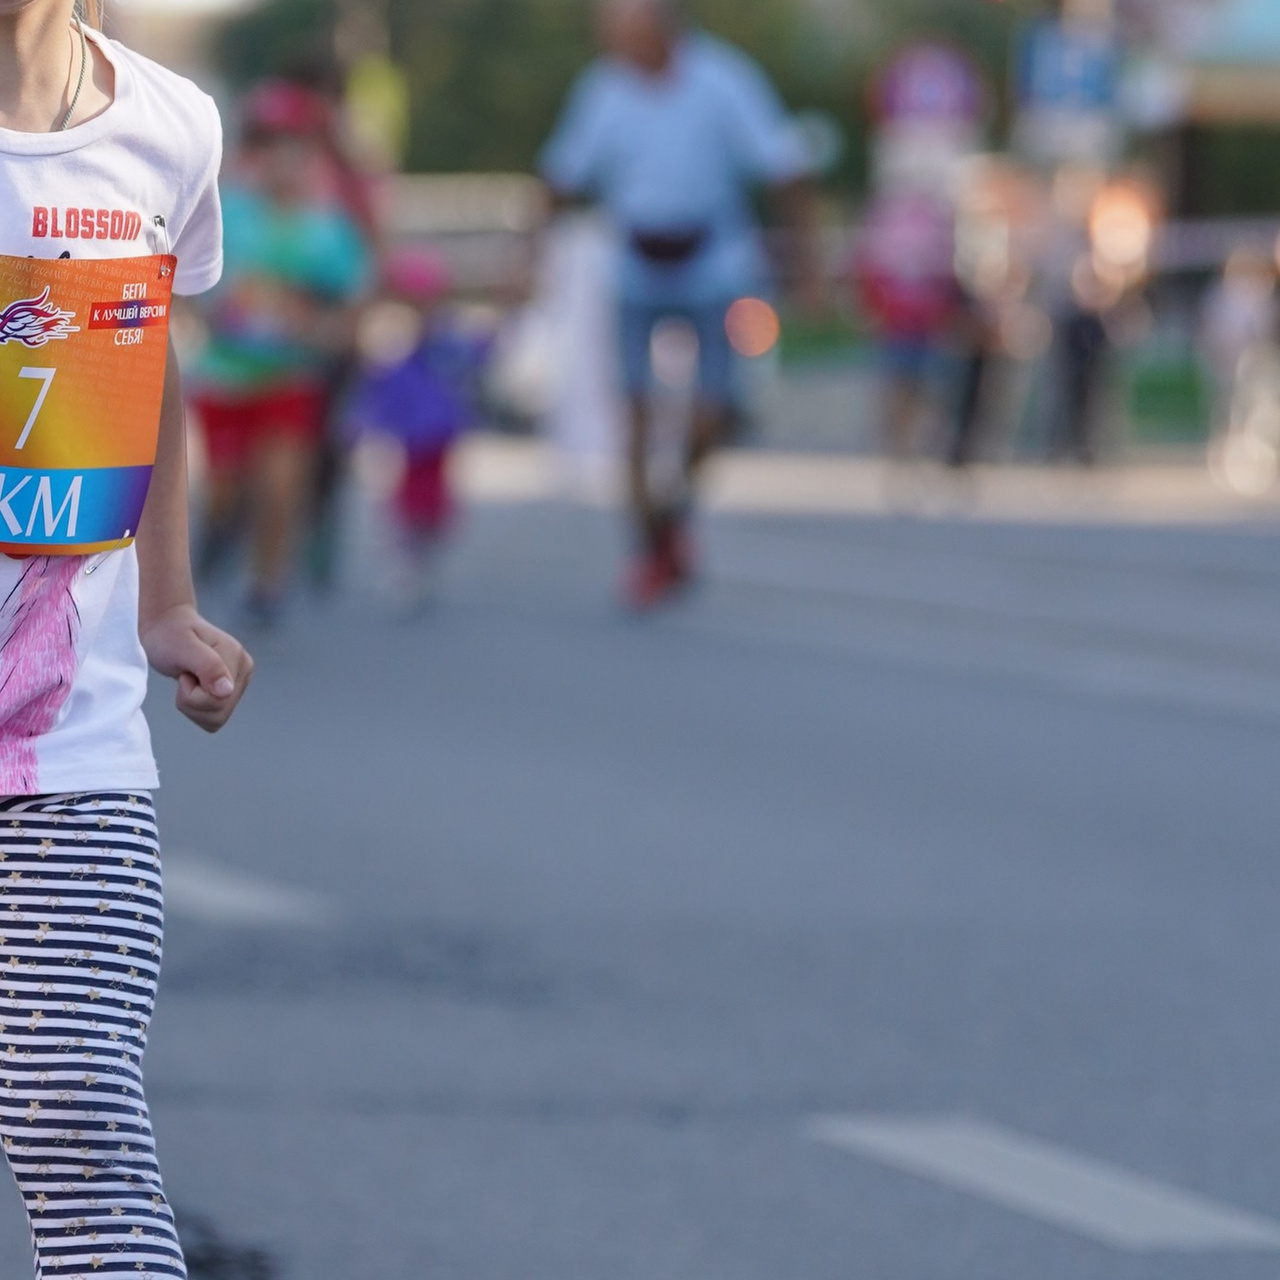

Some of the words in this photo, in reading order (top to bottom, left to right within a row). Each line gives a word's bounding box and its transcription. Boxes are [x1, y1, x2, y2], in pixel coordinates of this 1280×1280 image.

[32, 206, 141, 240] BLOSSOM
[122, 282, 147, 300] БЕГИ
[114, 328, 144, 346] СЕБЯ!
